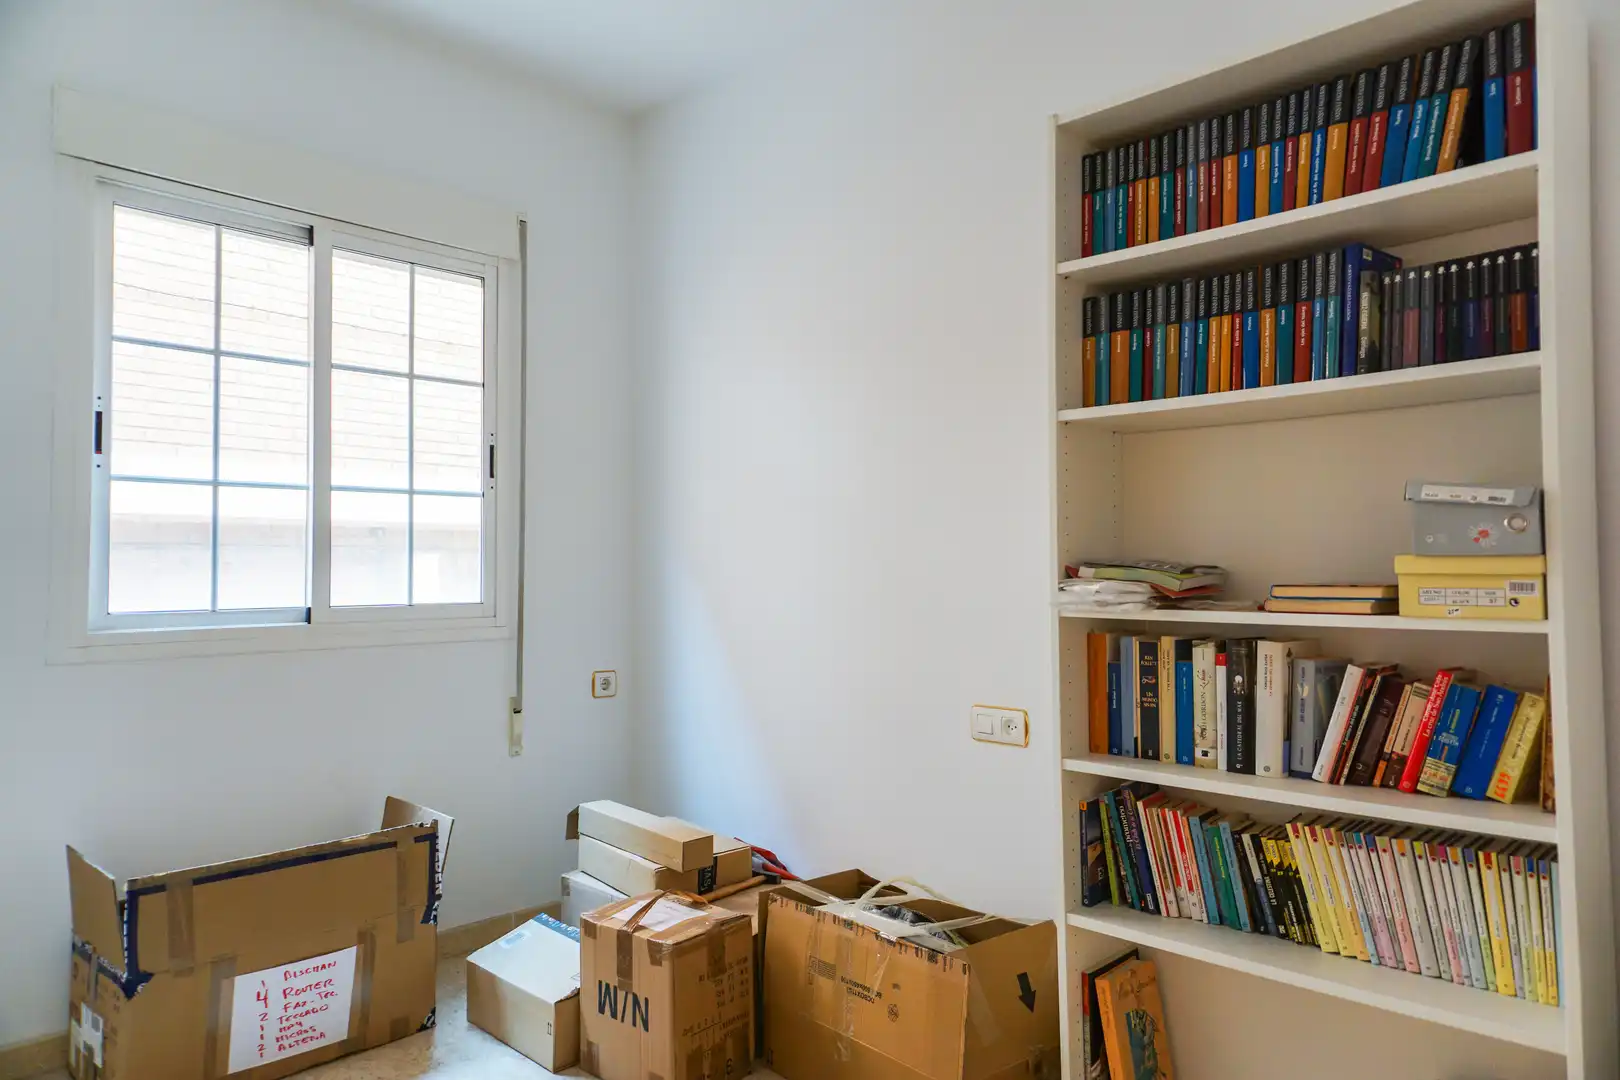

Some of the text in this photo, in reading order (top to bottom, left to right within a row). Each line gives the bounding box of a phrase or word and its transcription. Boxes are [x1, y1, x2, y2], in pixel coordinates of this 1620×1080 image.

[1200, 691, 1208, 719] GORDON
[1433, 696, 1442, 708] San
[1430, 708, 1438, 717] de
[1427, 716, 1435, 729] cruz
[1423, 728, 1431, 737] La
[1236, 752, 1243, 760] LA
[256, 978, 335, 1009] 4 ROUTER
[257, 1012, 269, 1022] 2
[281, 1001, 307, 1013] FAX
[256, 1025, 318, 1052] 2 MICROS
